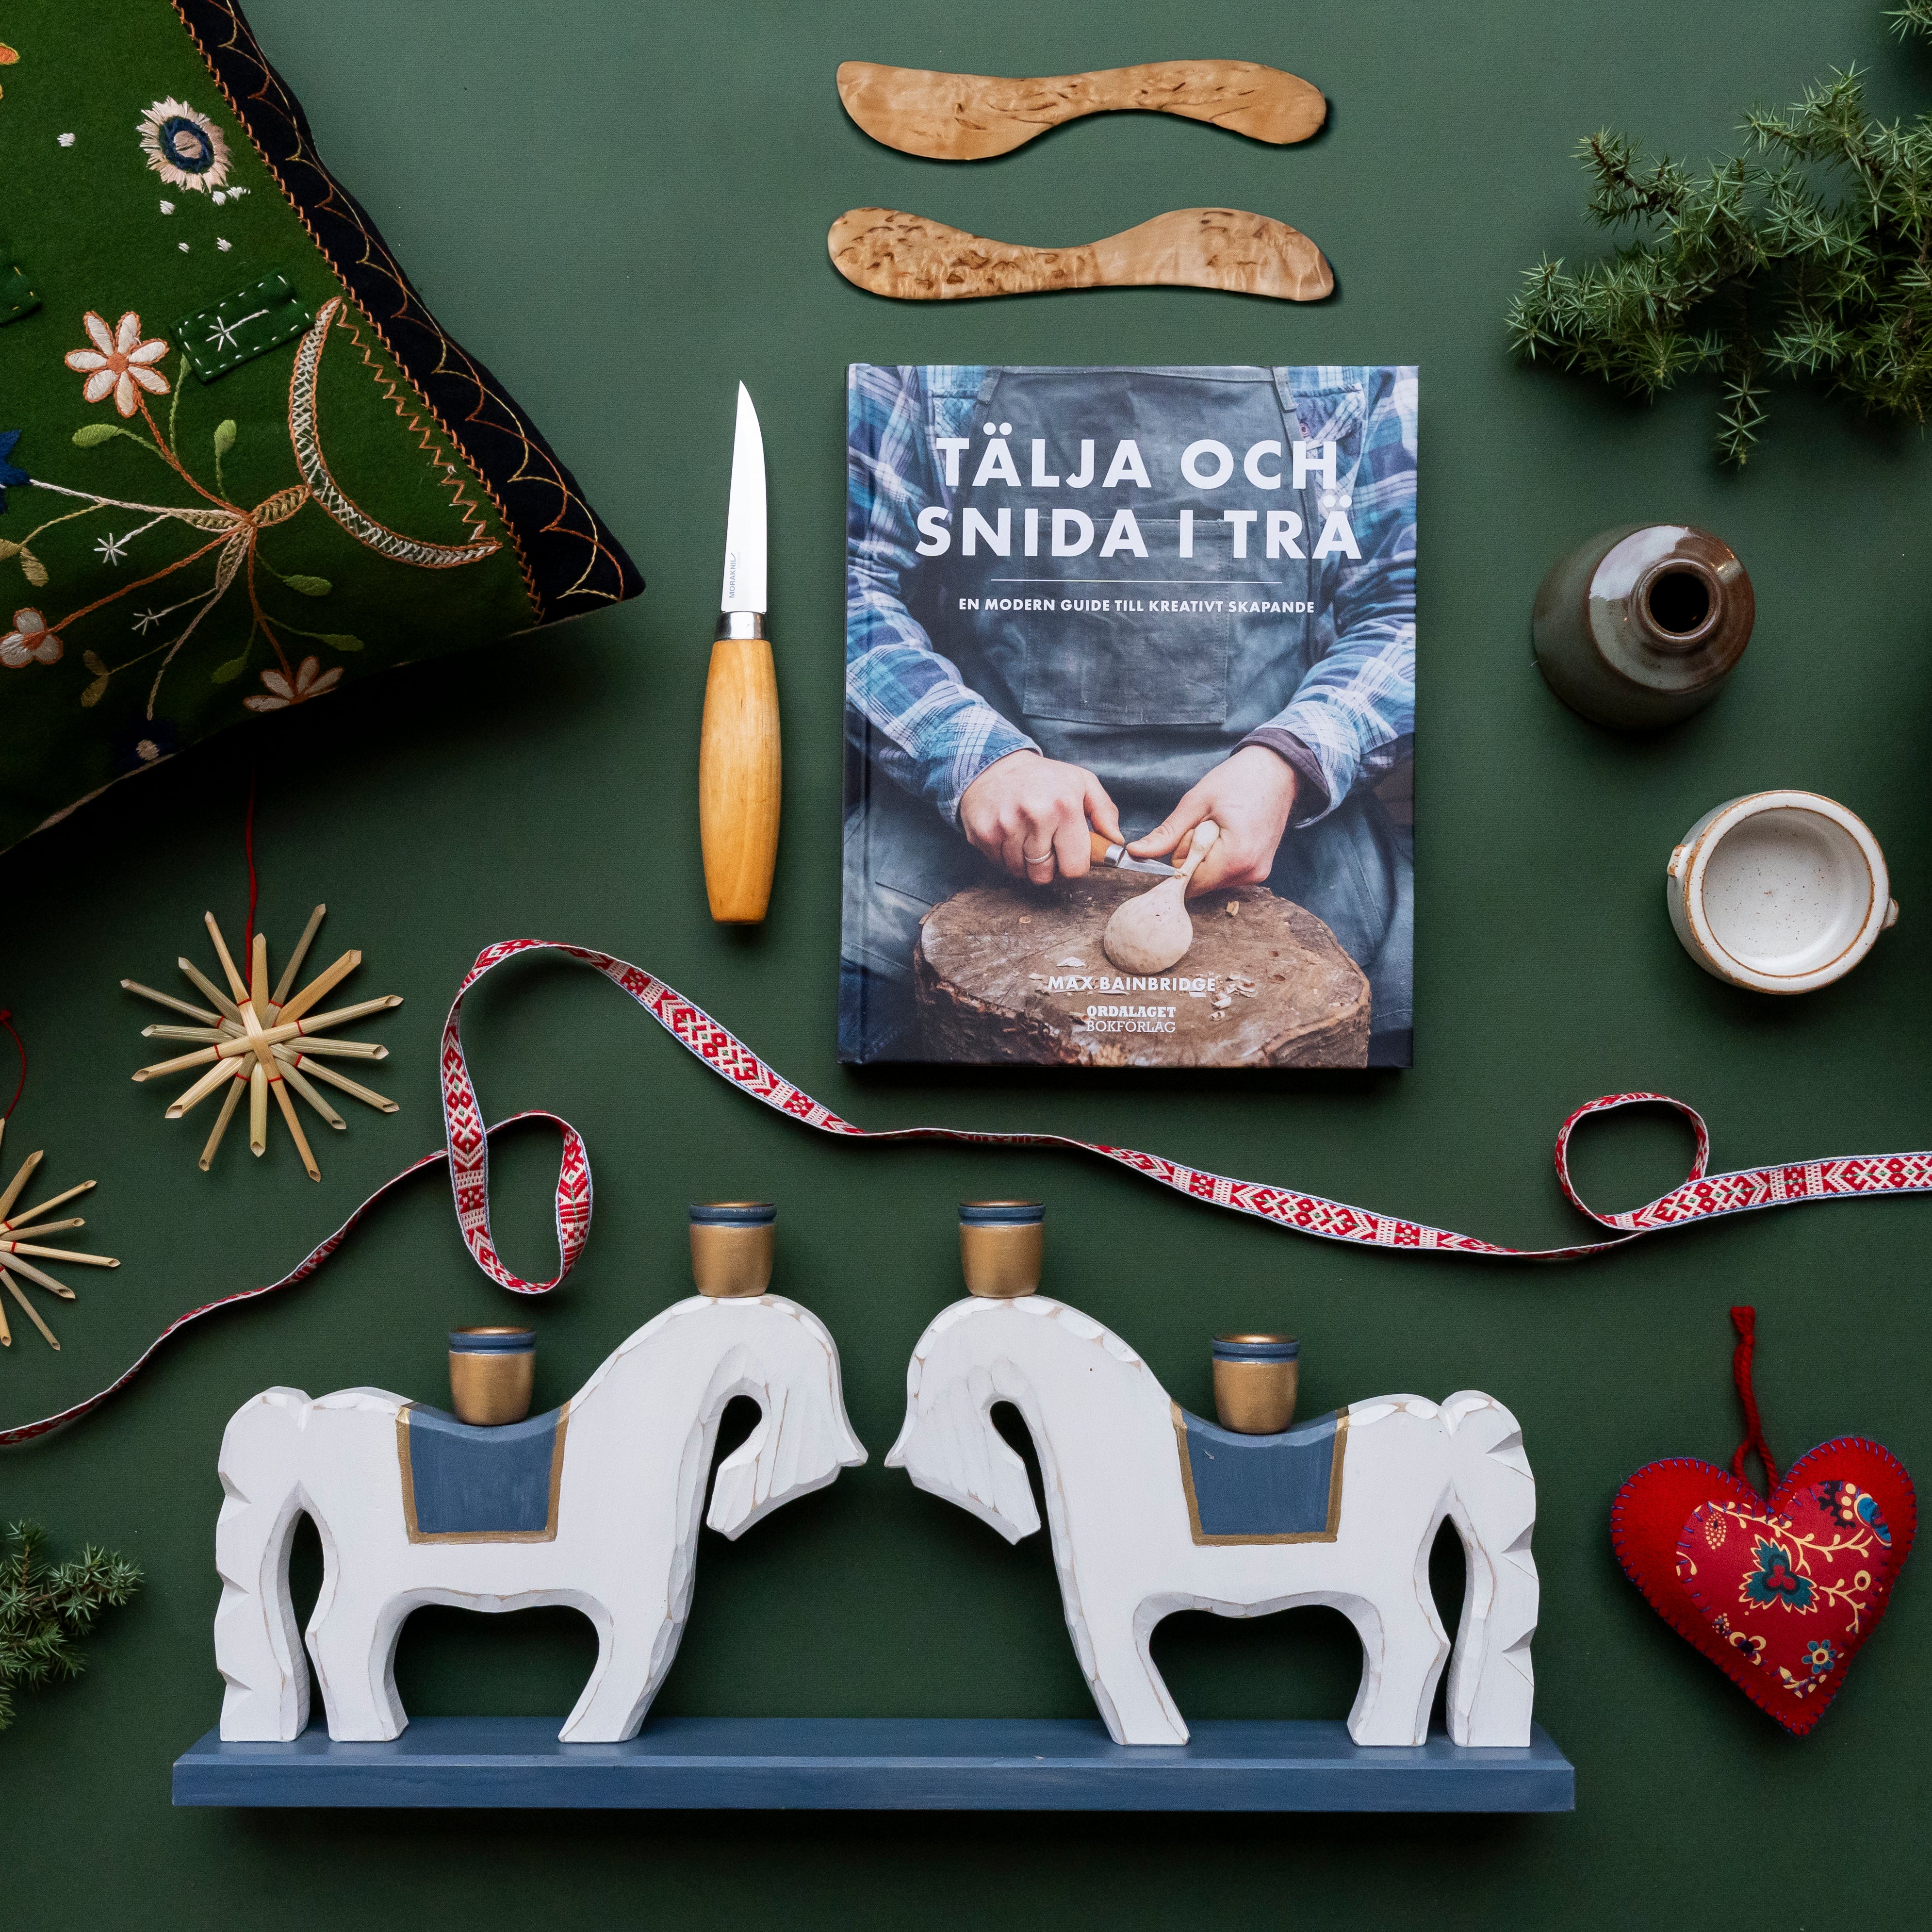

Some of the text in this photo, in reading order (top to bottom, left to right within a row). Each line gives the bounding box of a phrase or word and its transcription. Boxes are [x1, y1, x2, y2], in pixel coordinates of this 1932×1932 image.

[936, 422, 1339, 490] TÄLJA OCH
[915, 495, 1362, 559] SNIDA I TRÄ
[959, 598, 1314, 613] EN MODERN GUIDE TILL KREATIVT SKAPANDE
[1048, 975, 1215, 991] MAX BAINBRIDGE
[1086, 1005, 1176, 1018] ORDALAGET
[1086, 1019, 1176, 1033] BOKFÖRLAG
